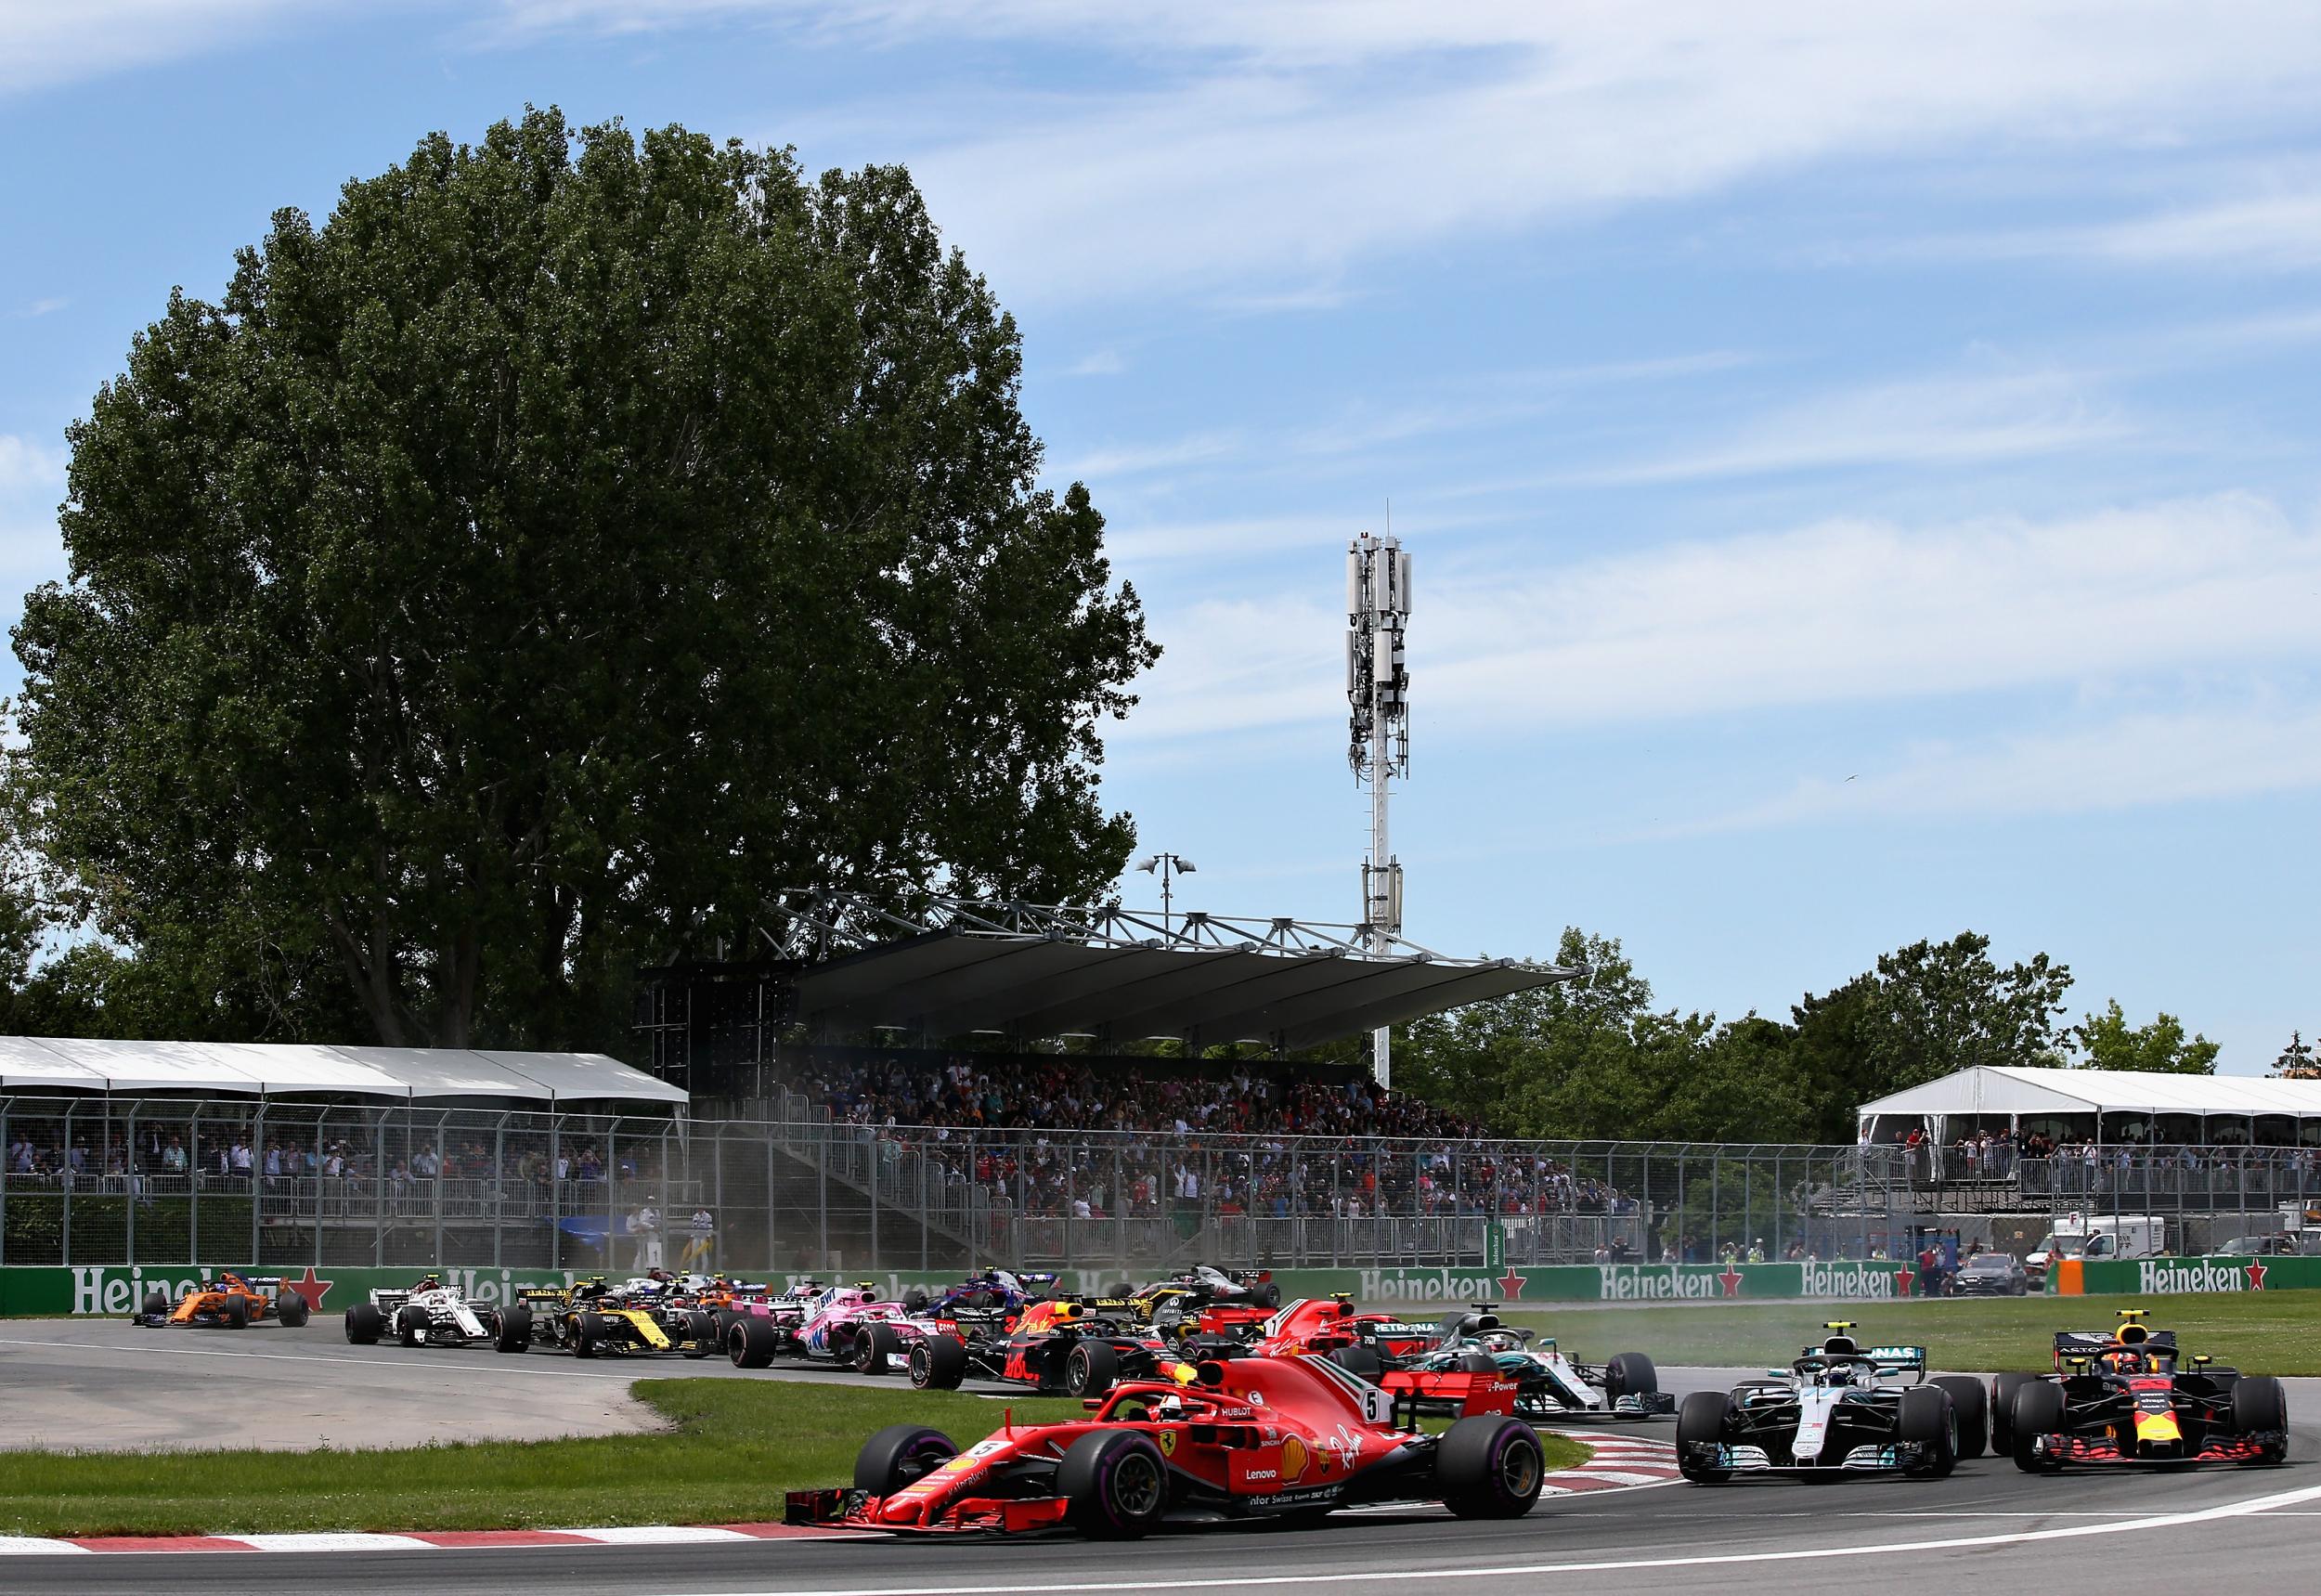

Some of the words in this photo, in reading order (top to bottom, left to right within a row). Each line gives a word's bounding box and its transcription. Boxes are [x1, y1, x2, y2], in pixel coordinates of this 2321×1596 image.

[2070, 1214, 2078, 1226] F
[1360, 1269, 1492, 1300] Heineken
[1600, 1265, 1715, 1300] Heineken
[1800, 1262, 1892, 1297] Heineken
[2139, 1260, 2242, 1293] Heineken
[820, 1287, 836, 1309] BWT
[1222, 1407, 1251, 1417] HUBLOT
[1367, 1391, 1378, 1421] 5
[974, 1443, 1000, 1455] 5
[1246, 1469, 1277, 1480] Lenovo
